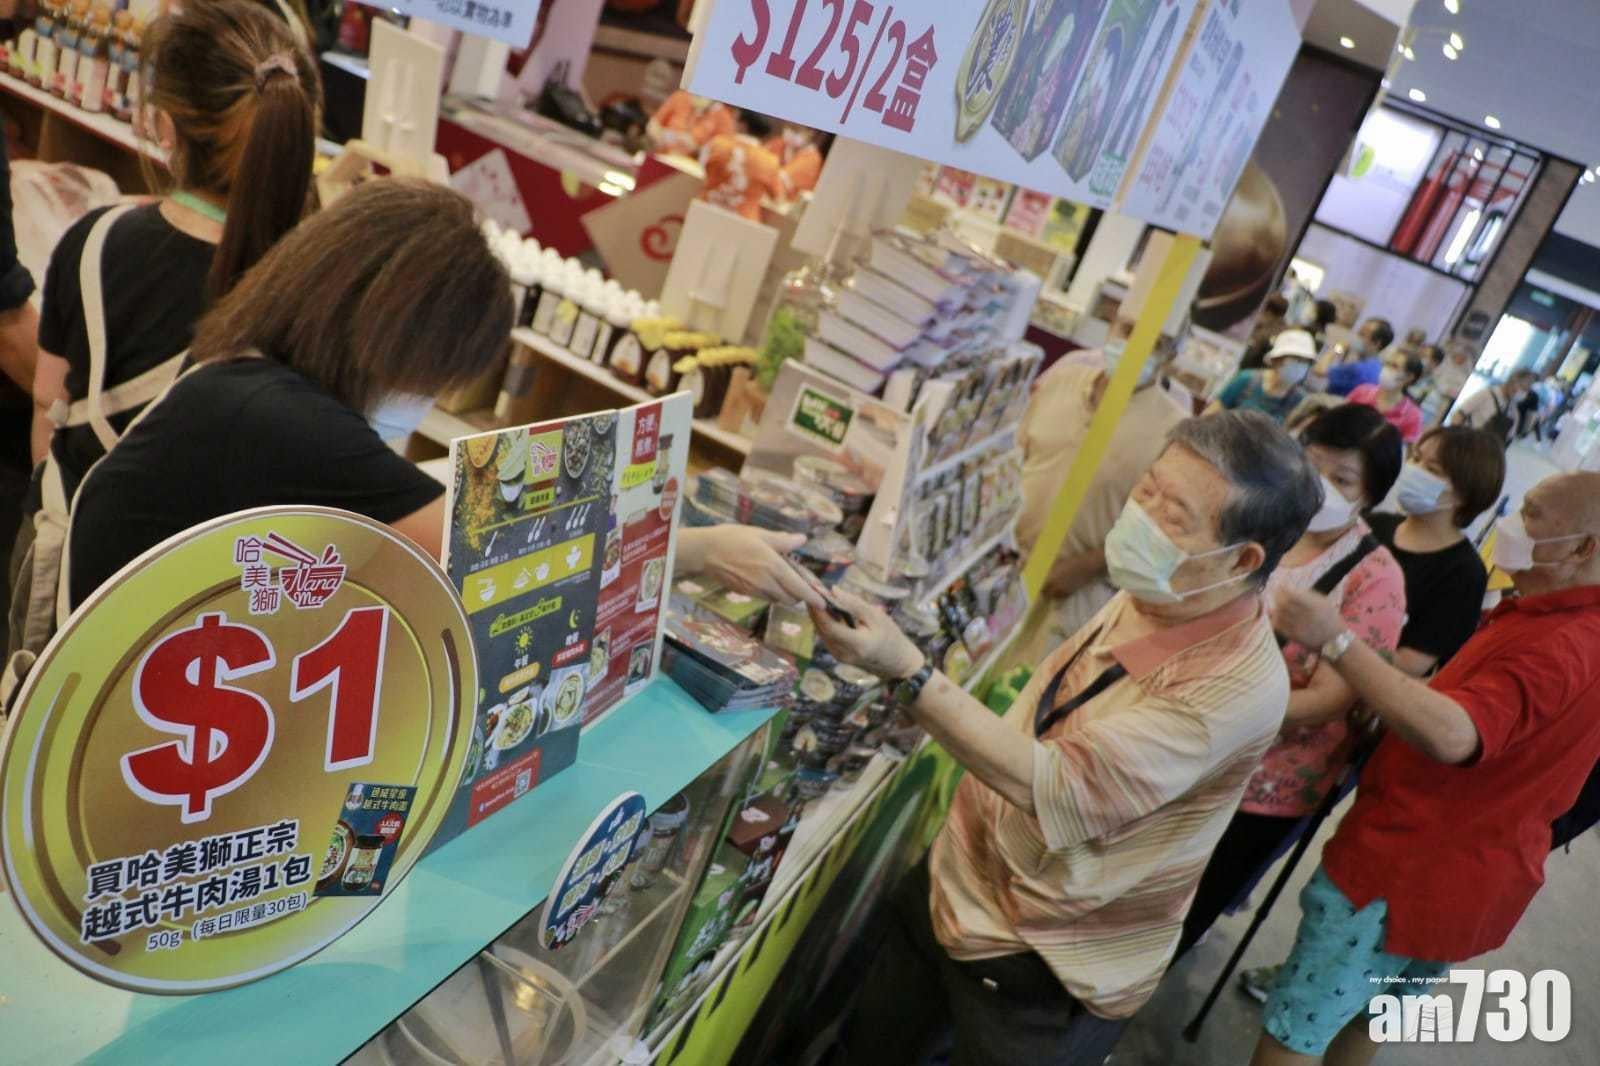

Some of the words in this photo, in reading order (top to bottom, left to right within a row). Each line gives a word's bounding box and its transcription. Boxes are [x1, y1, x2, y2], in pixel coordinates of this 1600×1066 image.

[236, 537, 279, 612] 哈美獅
[125, 608, 386, 816] $1
[82, 855, 312, 942] 越式牛肉湯1包
[88, 822, 297, 900] 買哈美獅正宗
[148, 933, 181, 950] 50g
[191, 893, 308, 940] (每日限量30包)
